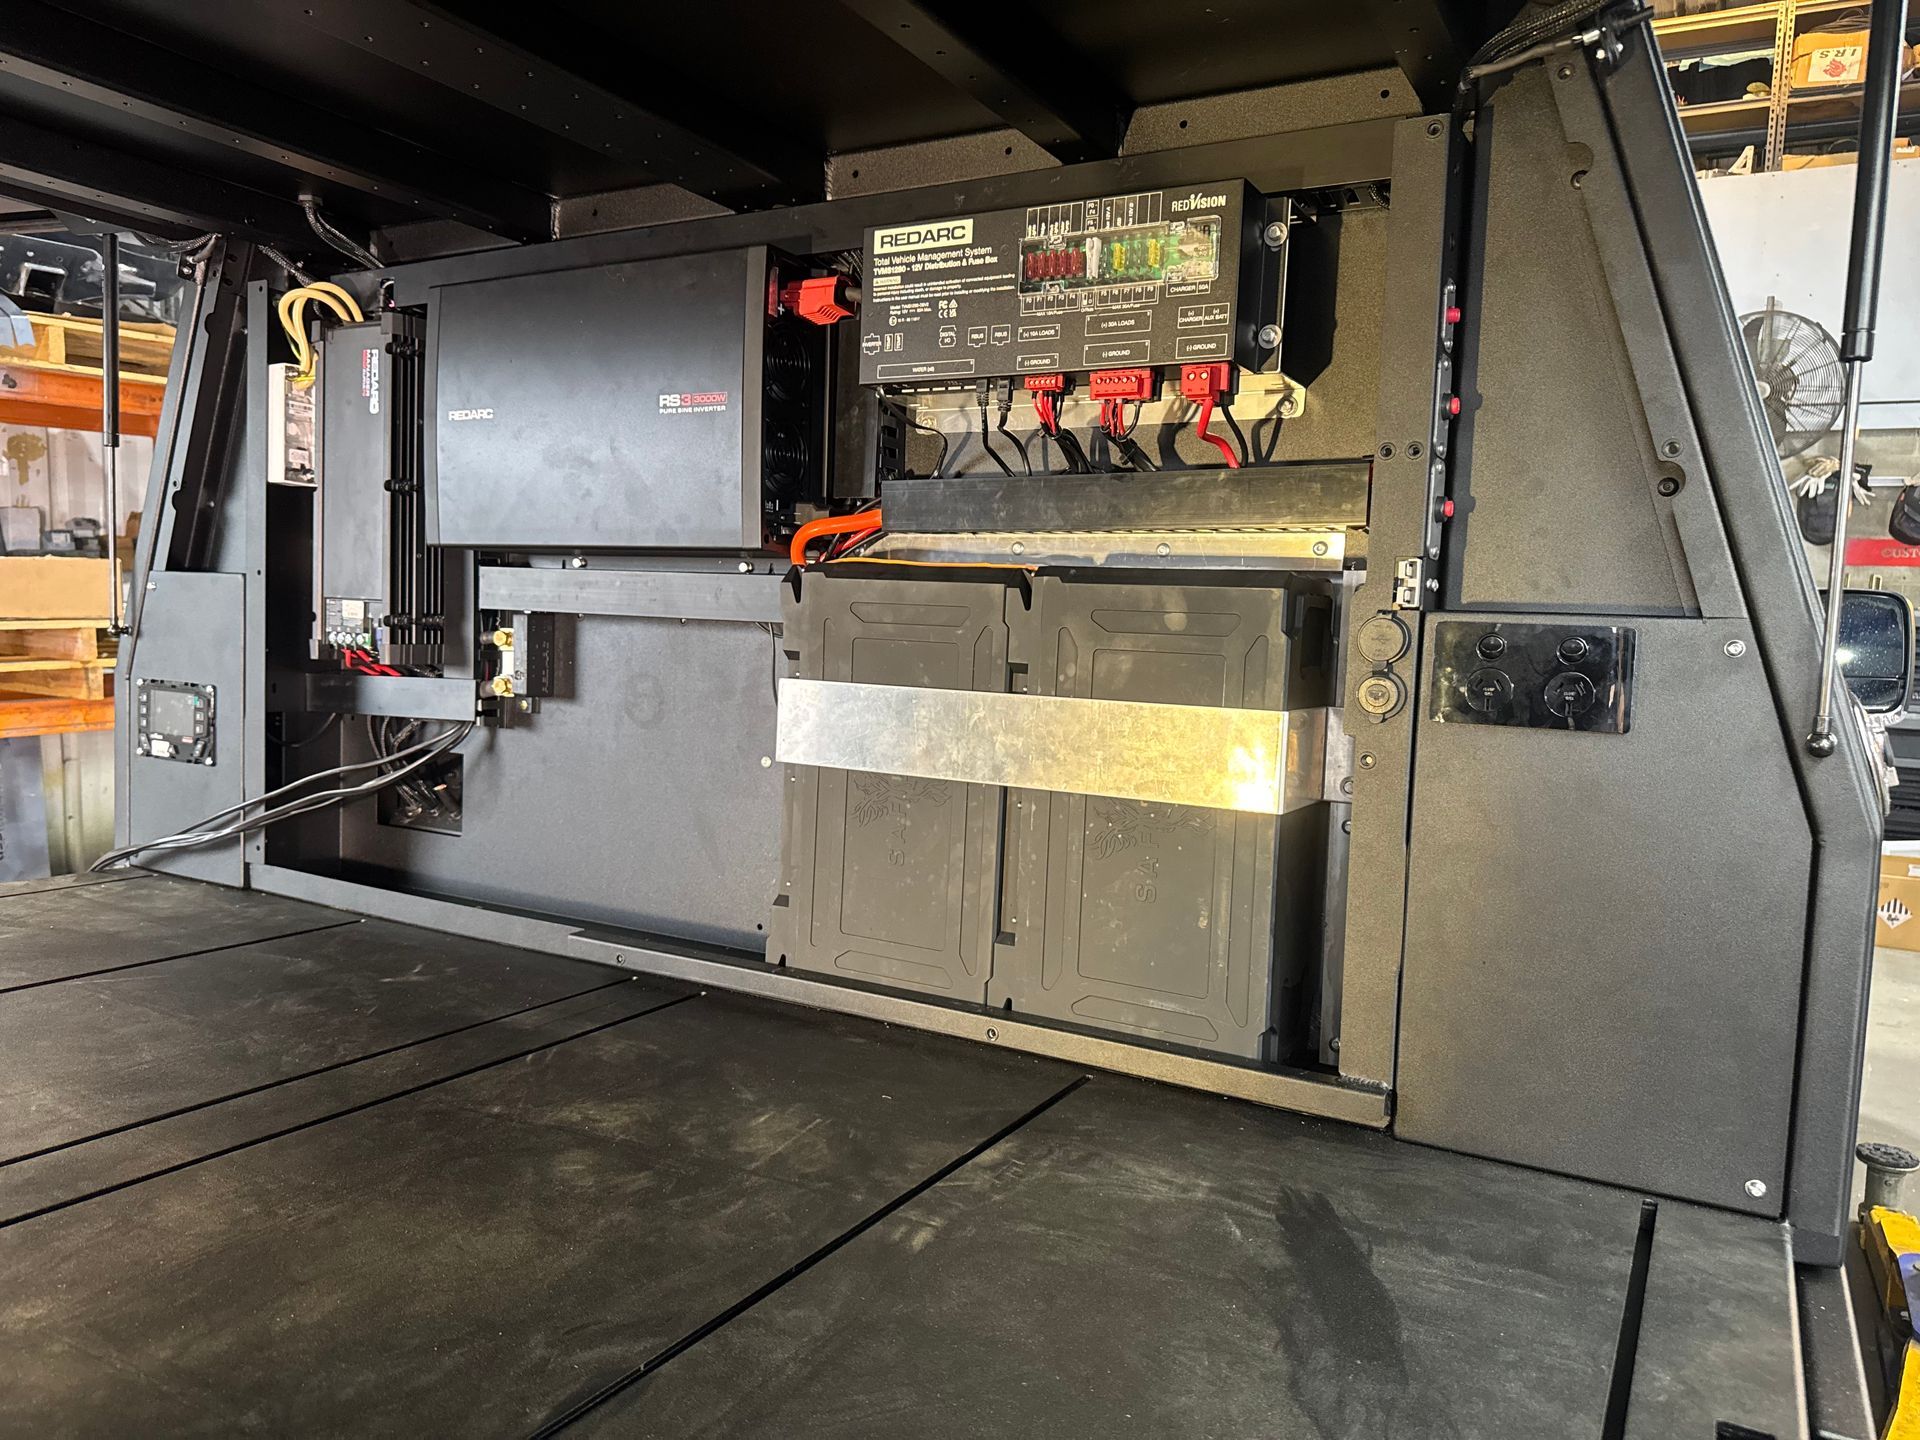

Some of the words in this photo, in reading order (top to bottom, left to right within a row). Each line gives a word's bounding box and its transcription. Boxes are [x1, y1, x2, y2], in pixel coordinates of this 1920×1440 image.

[1171, 193, 1227, 212] REDVISION
[881, 225, 966, 249] REDARC
[873, 256, 890, 267] Total
[891, 254, 916, 265] Vehicle
[917, 249, 964, 262] Management
[964, 246, 992, 258] System
[911, 263, 923, 272] 12V
[924, 260, 961, 271] Distribution
[961, 258, 968, 267] &
[968, 257, 984, 266] Fuse
[984, 255, 998, 264] Box
[1170, 284, 1197, 293] CHARGER
[1117, 319, 1135, 327] LOADS
[1192, 342, 1217, 350] GROUND
[1108, 349, 1131, 357] GROUND
[1030, 358, 1051, 366] GROUND
[370, 349, 379, 414] REDARC
[659, 393, 691, 407] RS3
[693, 394, 727, 404] 3000W
[448, 408, 494, 421] REDARC
[659, 407, 677, 415] PURE
[693, 405, 727, 413] INVERTER
[1881, 548, 1920, 559] CUST
